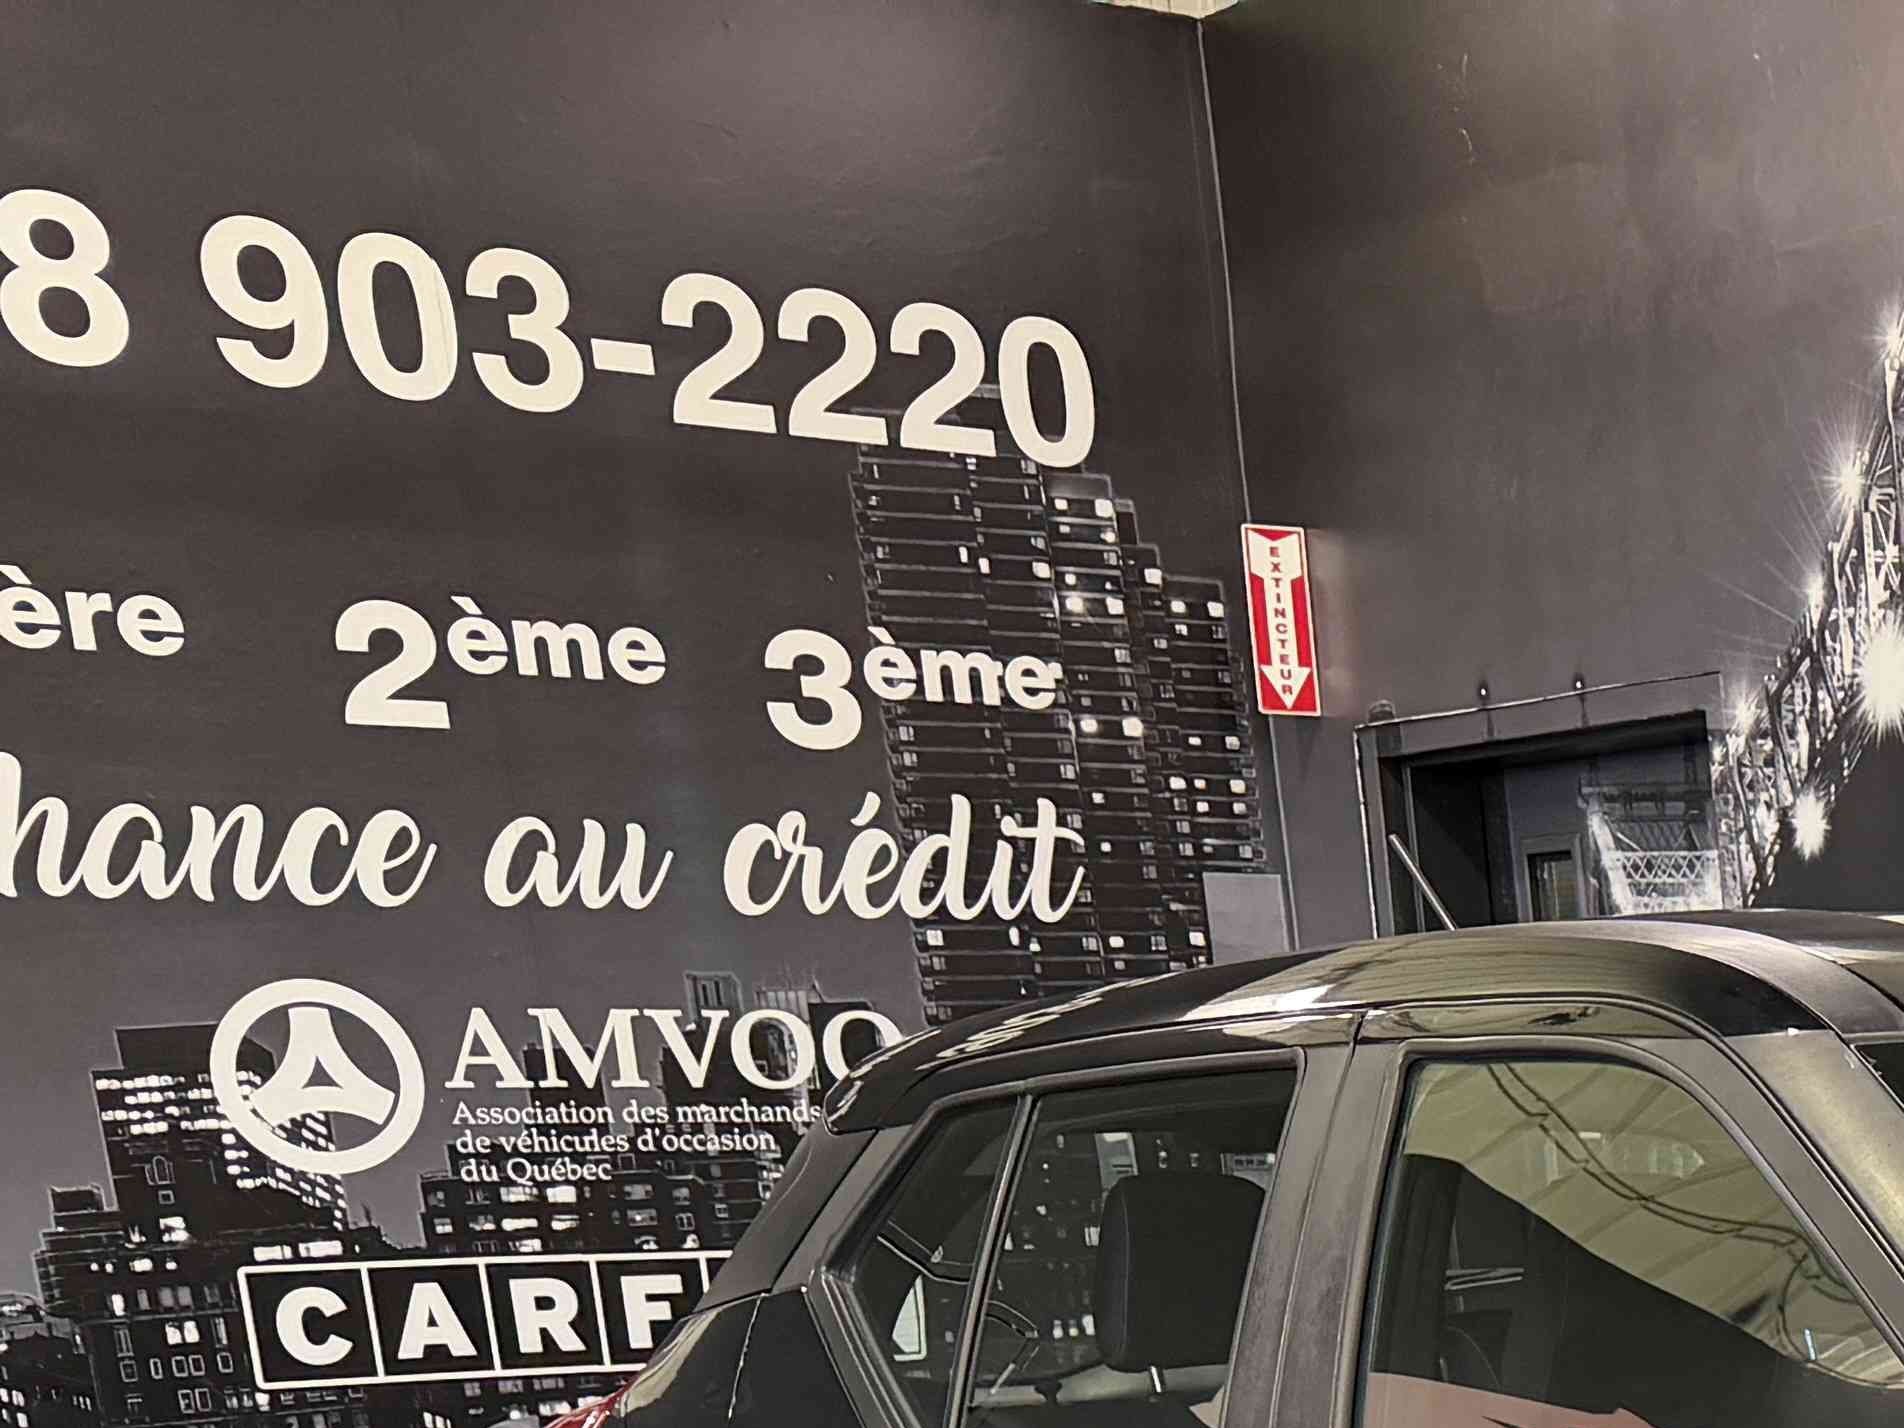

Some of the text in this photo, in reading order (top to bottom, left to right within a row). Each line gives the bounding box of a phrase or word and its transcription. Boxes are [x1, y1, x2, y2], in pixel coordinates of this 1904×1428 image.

[200, 215, 1095, 468] 903-2220
[335, 596, 666, 729] 2ème
[764, 626, 1063, 750] 3ème
[1269, 546, 1294, 695] EXTINCTEUR
[484, 816, 674, 910] au
[723, 793, 1086, 923] crédit
[452, 1101, 821, 1126] Association des marchands
[456, 1128, 777, 1154] de véhicules d'occasion
[460, 1157, 613, 1185] du Québec
